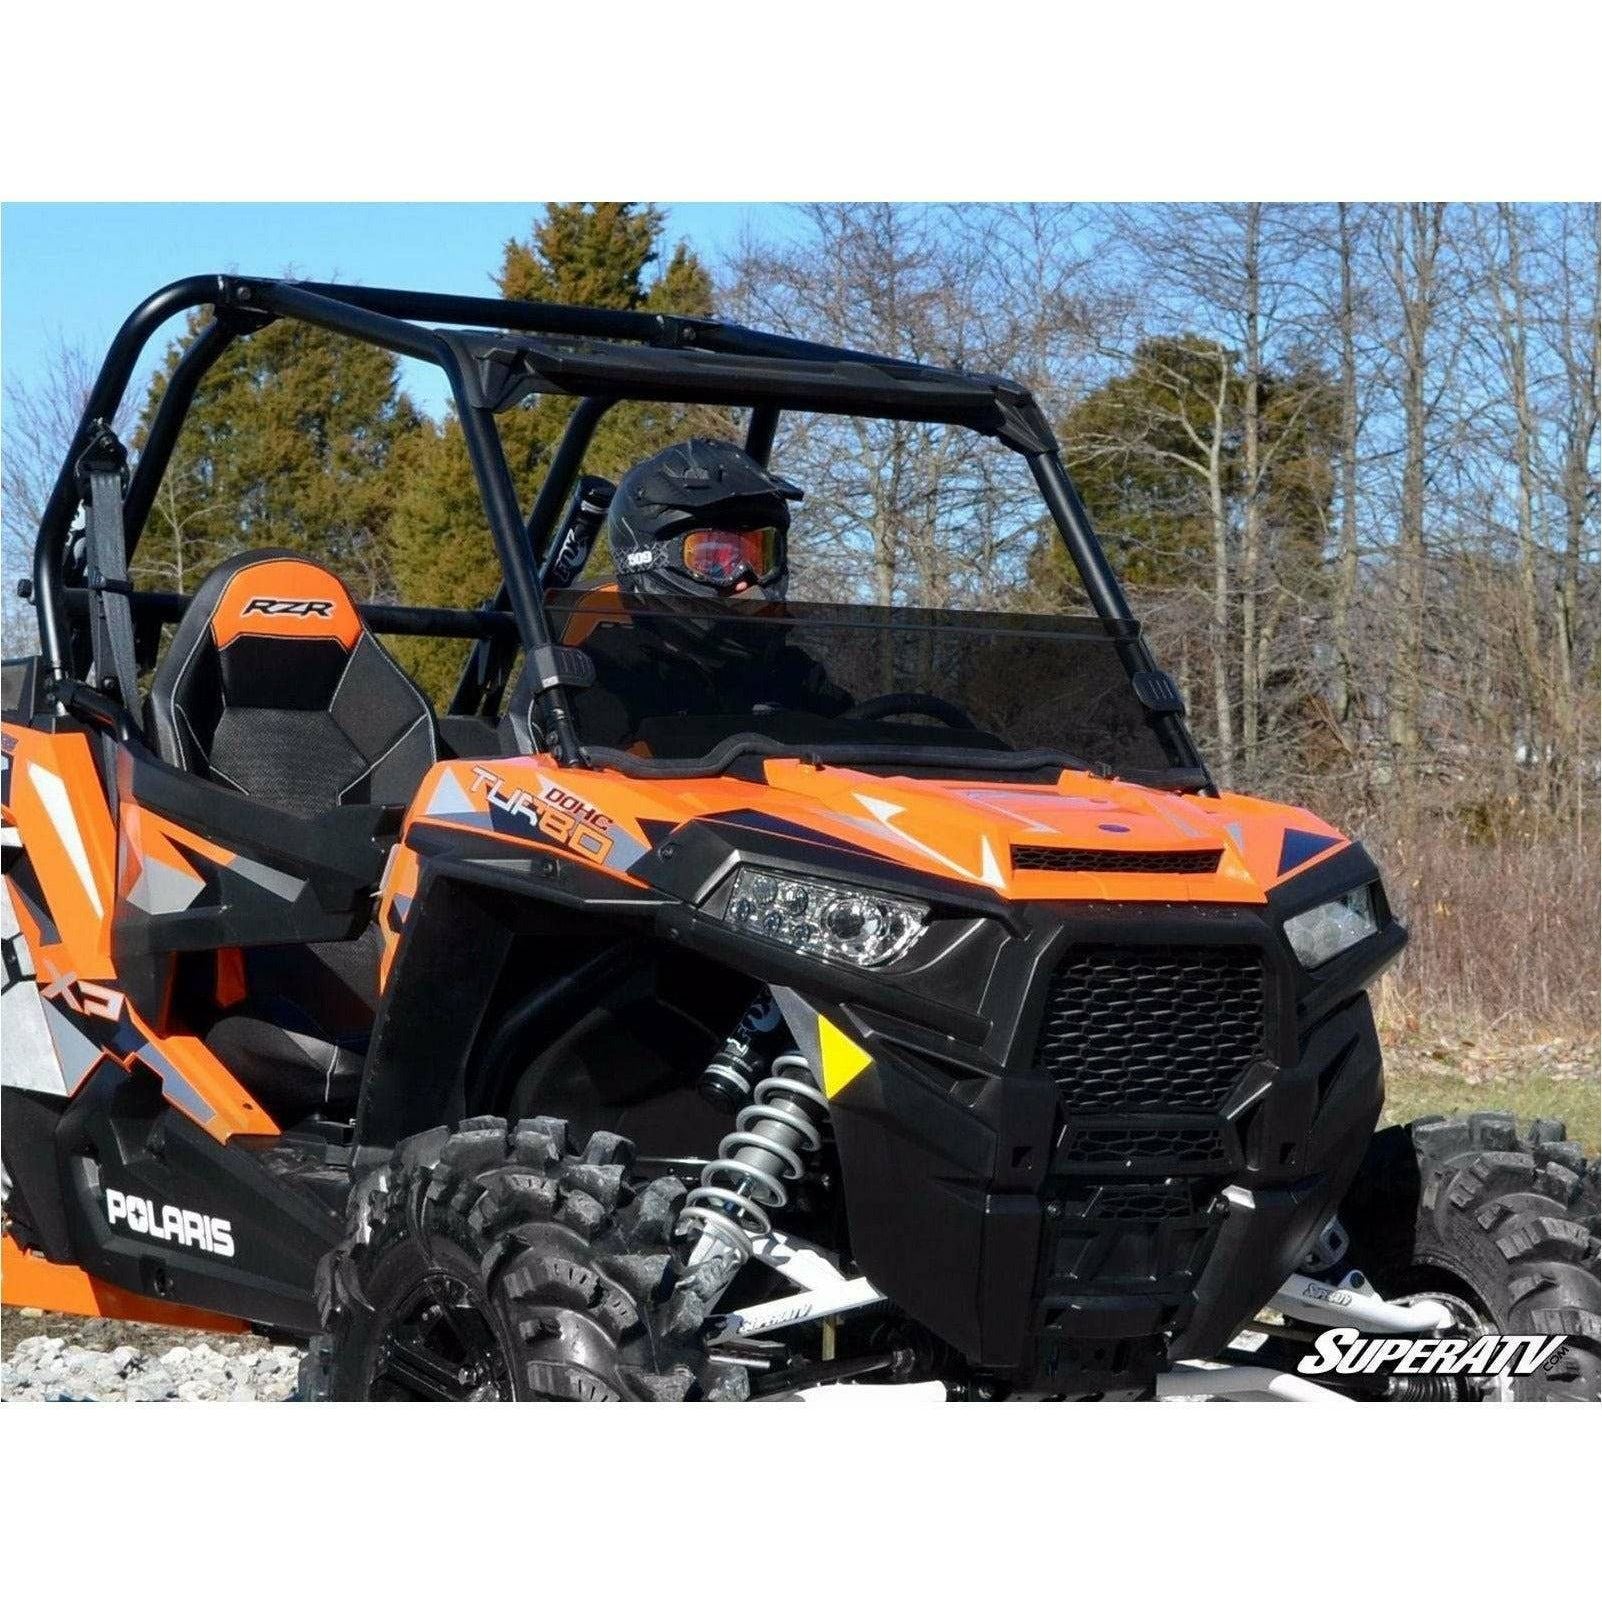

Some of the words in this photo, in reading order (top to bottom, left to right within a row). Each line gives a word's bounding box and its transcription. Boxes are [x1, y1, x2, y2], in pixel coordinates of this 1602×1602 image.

[241, 597, 336, 618] RZR
[39, 958, 125, 1022] XP
[105, 1188, 235, 1257] POLARIS
